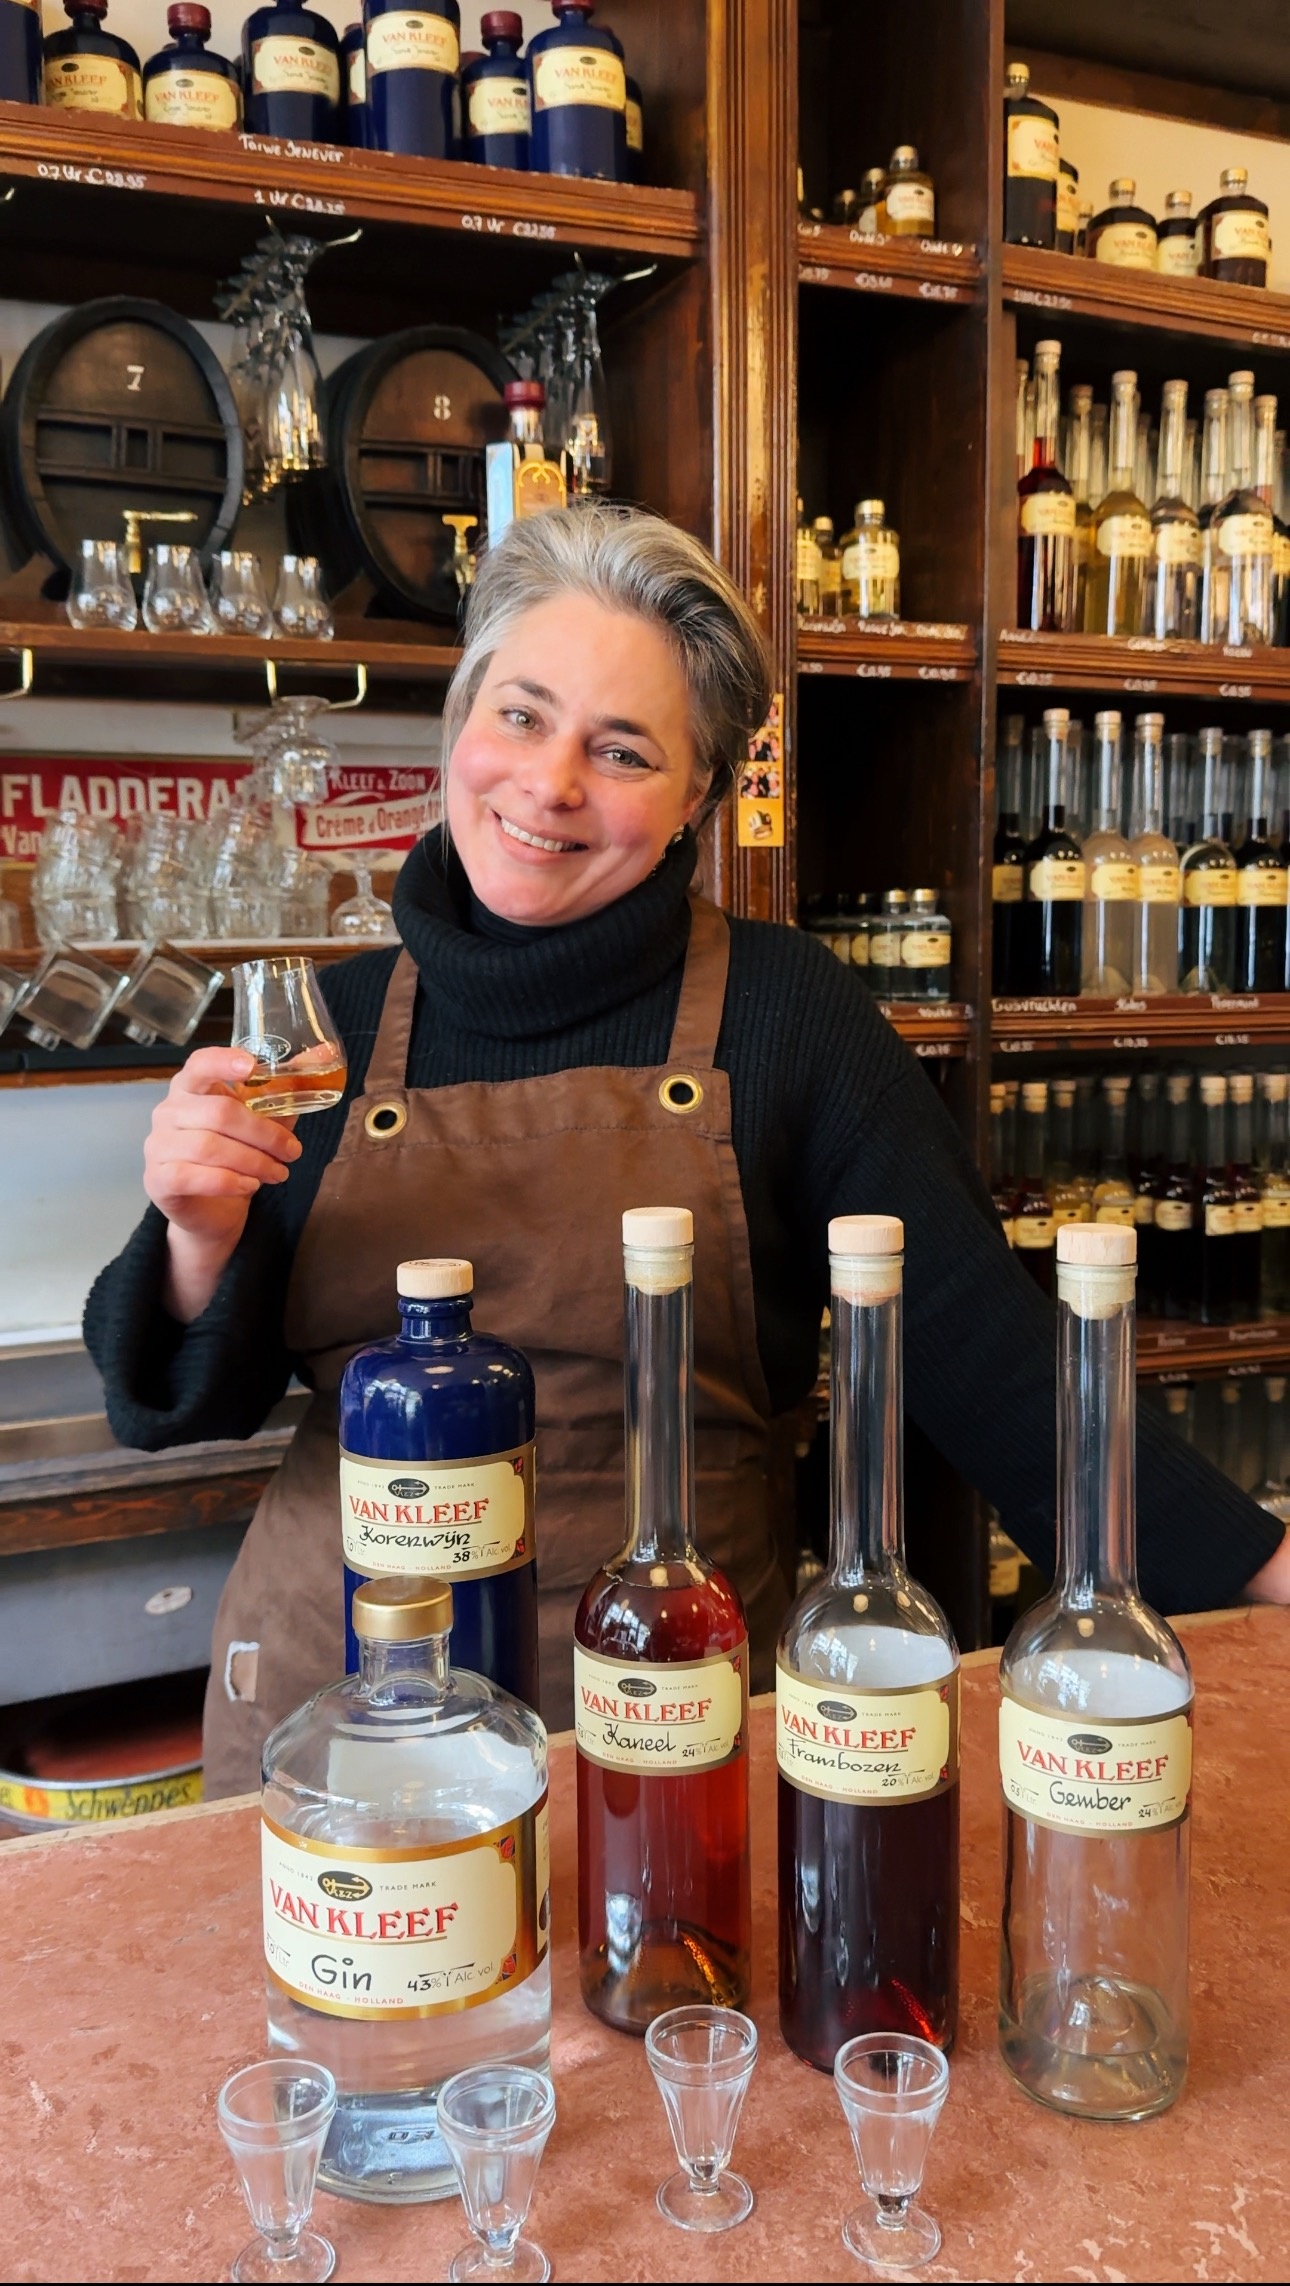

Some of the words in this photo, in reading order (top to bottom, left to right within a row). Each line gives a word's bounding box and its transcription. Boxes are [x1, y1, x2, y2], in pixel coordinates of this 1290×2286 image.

[126, 364, 145, 392] 7
[432, 394, 452, 421] 8
[349, 1494, 390, 1522] VAN
[394, 1497, 490, 1525] KLEEF
[580, 1686, 620, 1717] VAN
[624, 1697, 712, 1723] KLEEF
[602, 1722, 677, 1752] Kaneel
[781, 1704, 819, 1740] VAN
[823, 1724, 917, 1750] KLEEF
[787, 1738, 902, 1773] Frambozen
[1017, 1739, 1068, 1775] VAN
[1075, 1754, 1169, 1782] KLEEF
[65, 1782, 192, 1821] Schweppes
[1049, 1780, 1132, 1812] Gember
[379, 1884, 409, 1893] TRADE
[412, 1881, 438, 1890] MARK
[269, 1877, 320, 1929] VAN
[327, 1901, 459, 1940] KLEEF
[311, 1954, 372, 1992] Gin
[299, 1981, 314, 1993] DEN
[317, 1988, 341, 2000] HAAG
[355, 1995, 404, 2005] HOLLAND
